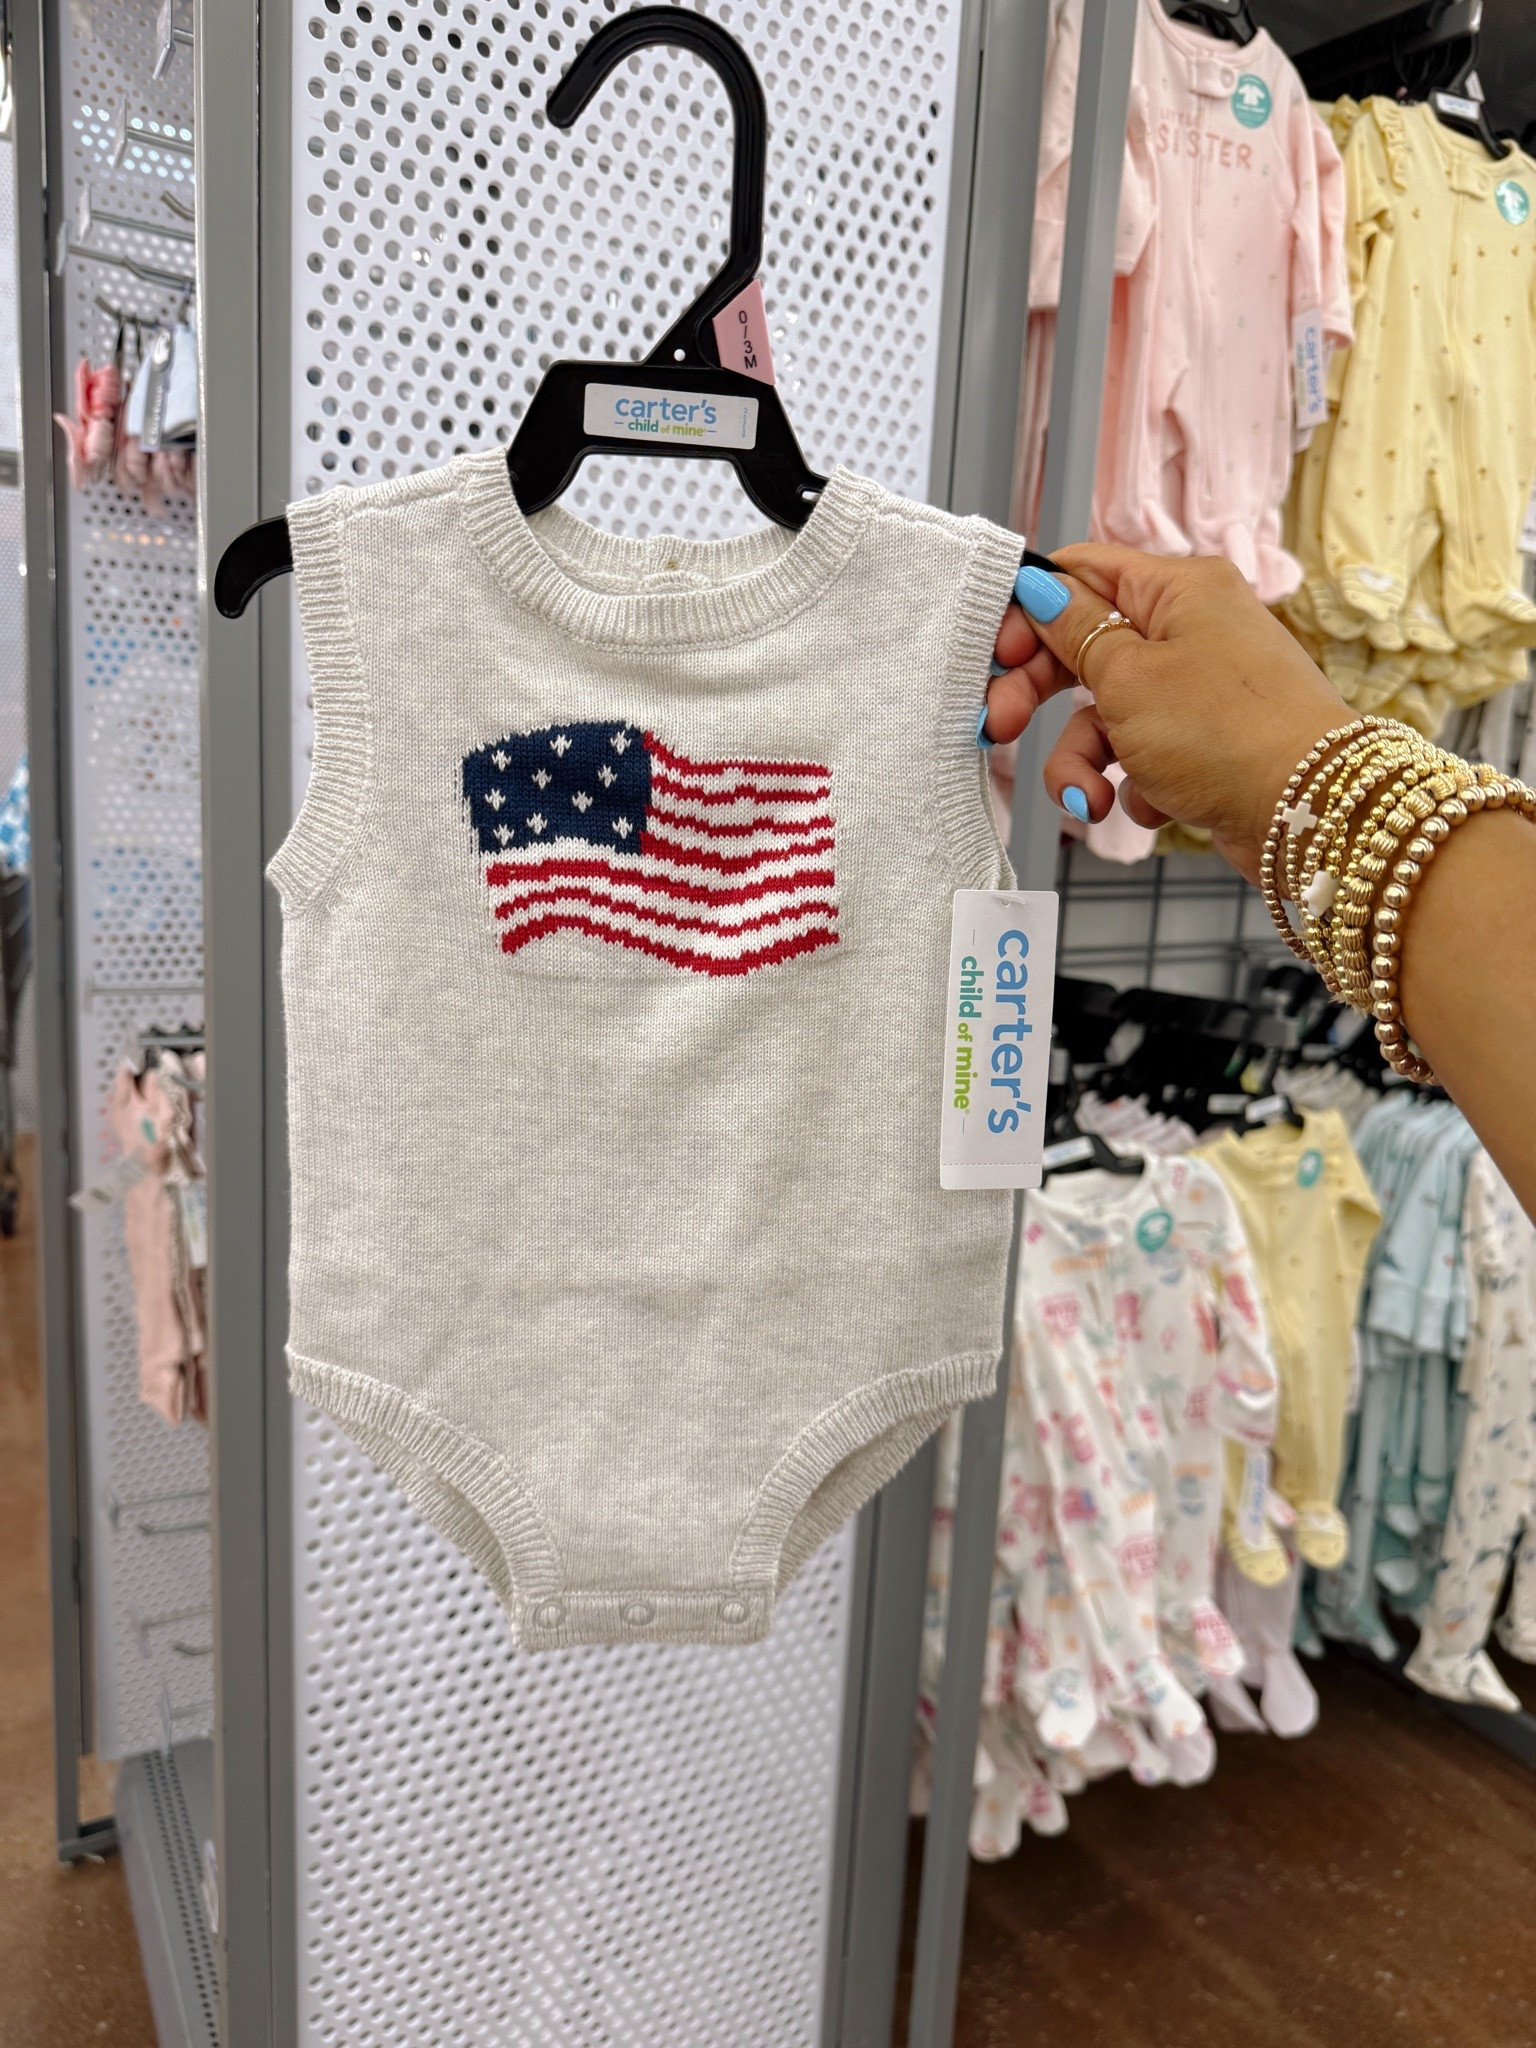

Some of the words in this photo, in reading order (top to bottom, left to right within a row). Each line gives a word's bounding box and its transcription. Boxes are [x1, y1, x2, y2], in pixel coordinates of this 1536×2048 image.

[1157, 123, 1252, 170] SISTER
[615, 398, 717, 424] carter's
[628, 419, 659, 432] child
[660, 425, 671, 433] of
[672, 423, 704, 436] mine
[959, 956, 984, 1018] child
[957, 1022, 973, 1042] of
[987, 930, 1033, 1133] carter's
[953, 1046, 978, 1110] mine
